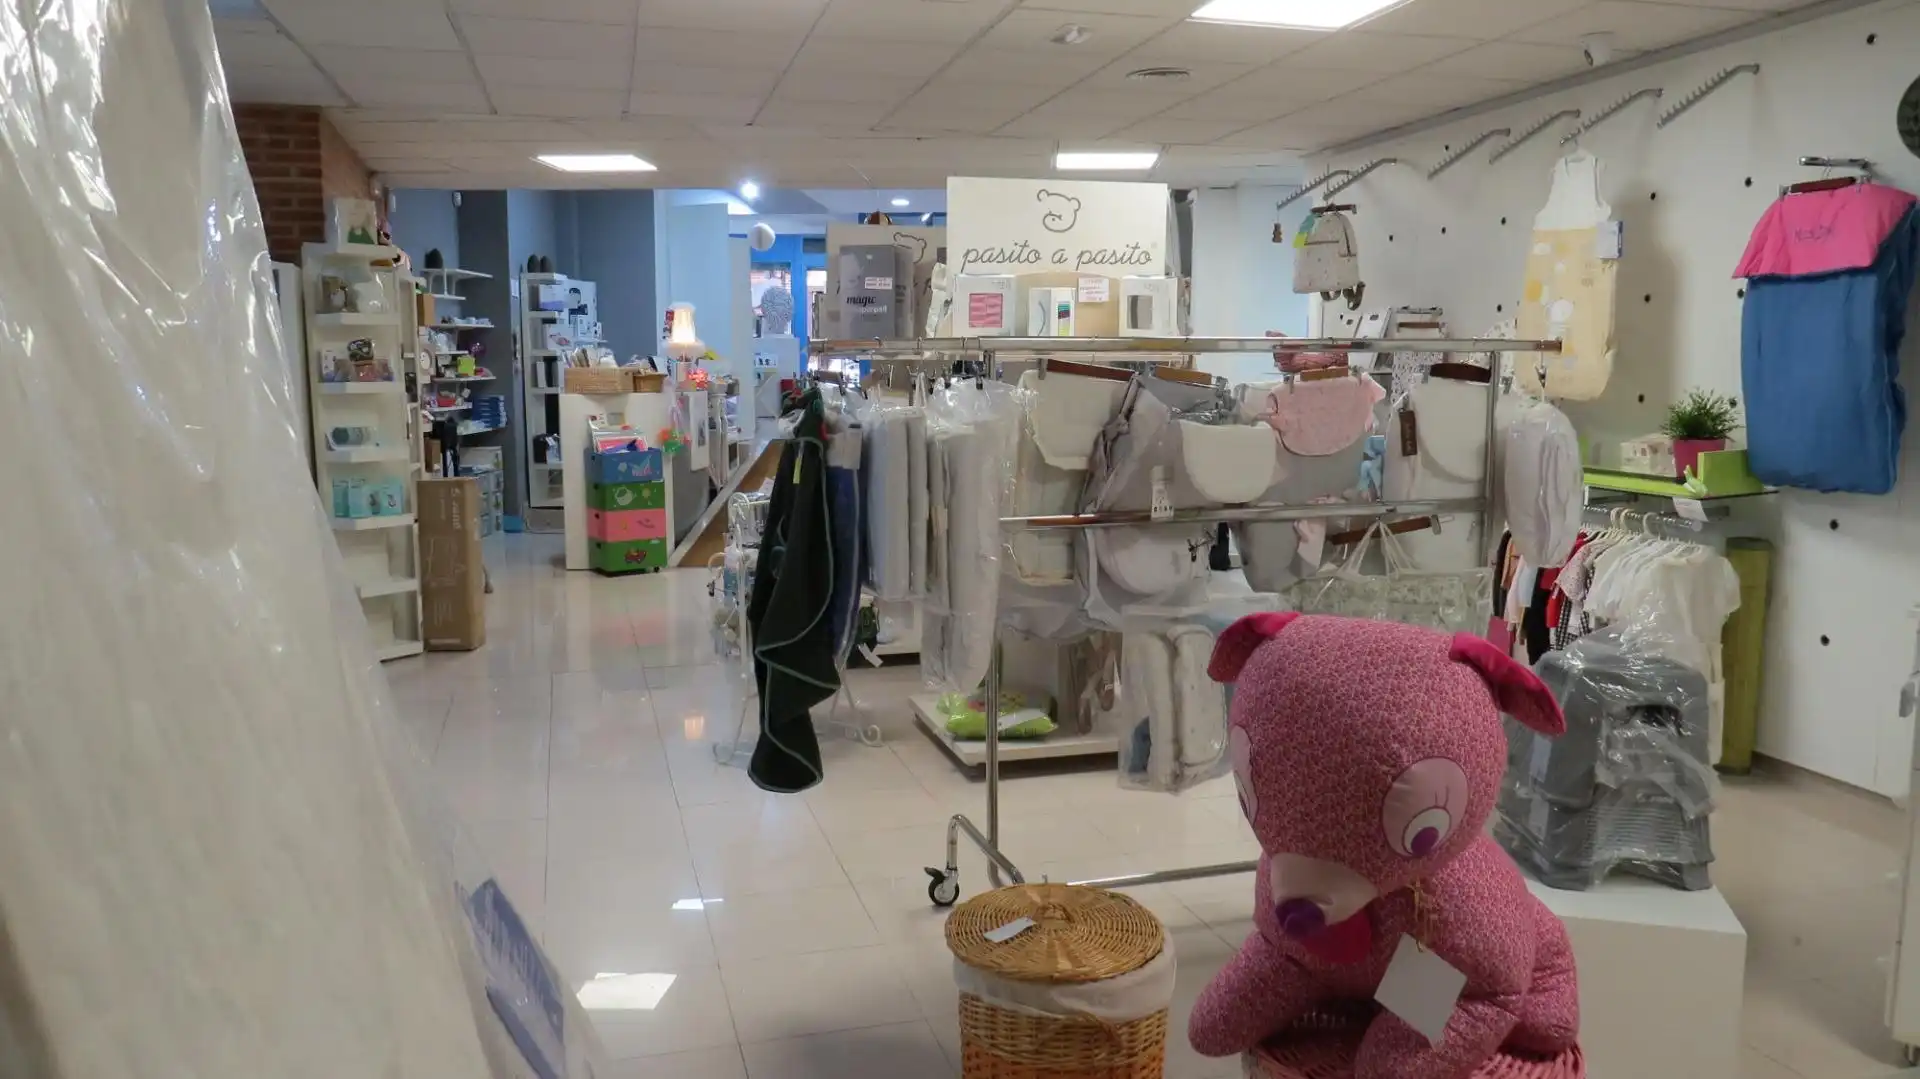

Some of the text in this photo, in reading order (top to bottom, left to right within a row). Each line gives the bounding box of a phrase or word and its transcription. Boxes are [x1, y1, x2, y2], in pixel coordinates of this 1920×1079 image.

[959, 240, 1153, 273] pasito a pasito
[846, 295, 877, 308] magic
